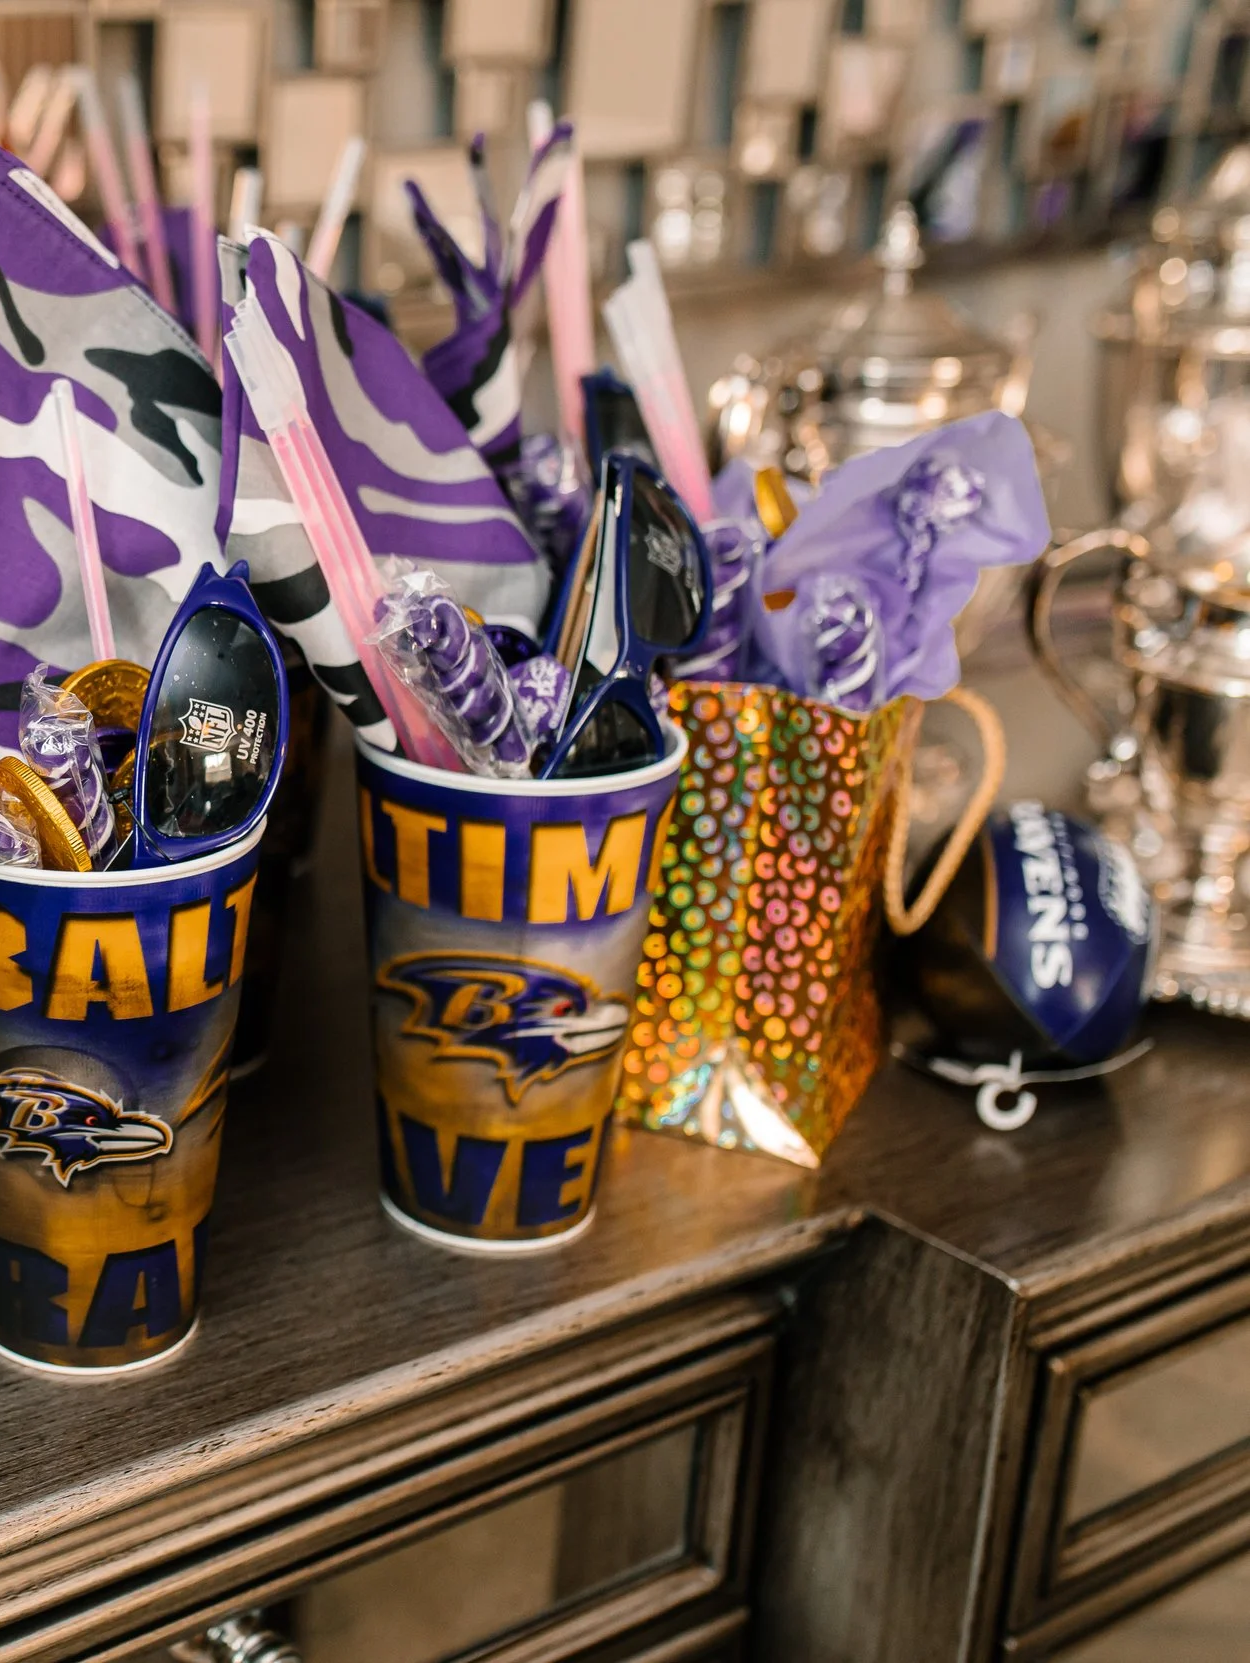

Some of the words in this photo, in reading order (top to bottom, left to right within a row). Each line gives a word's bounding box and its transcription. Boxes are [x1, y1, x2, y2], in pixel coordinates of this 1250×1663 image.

[202, 710, 228, 747] NFL
[243, 709, 257, 737] 400
[250, 712, 267, 764] PROTECTION
[236, 738, 251, 760] UV
[378, 1092, 615, 1227] VE
